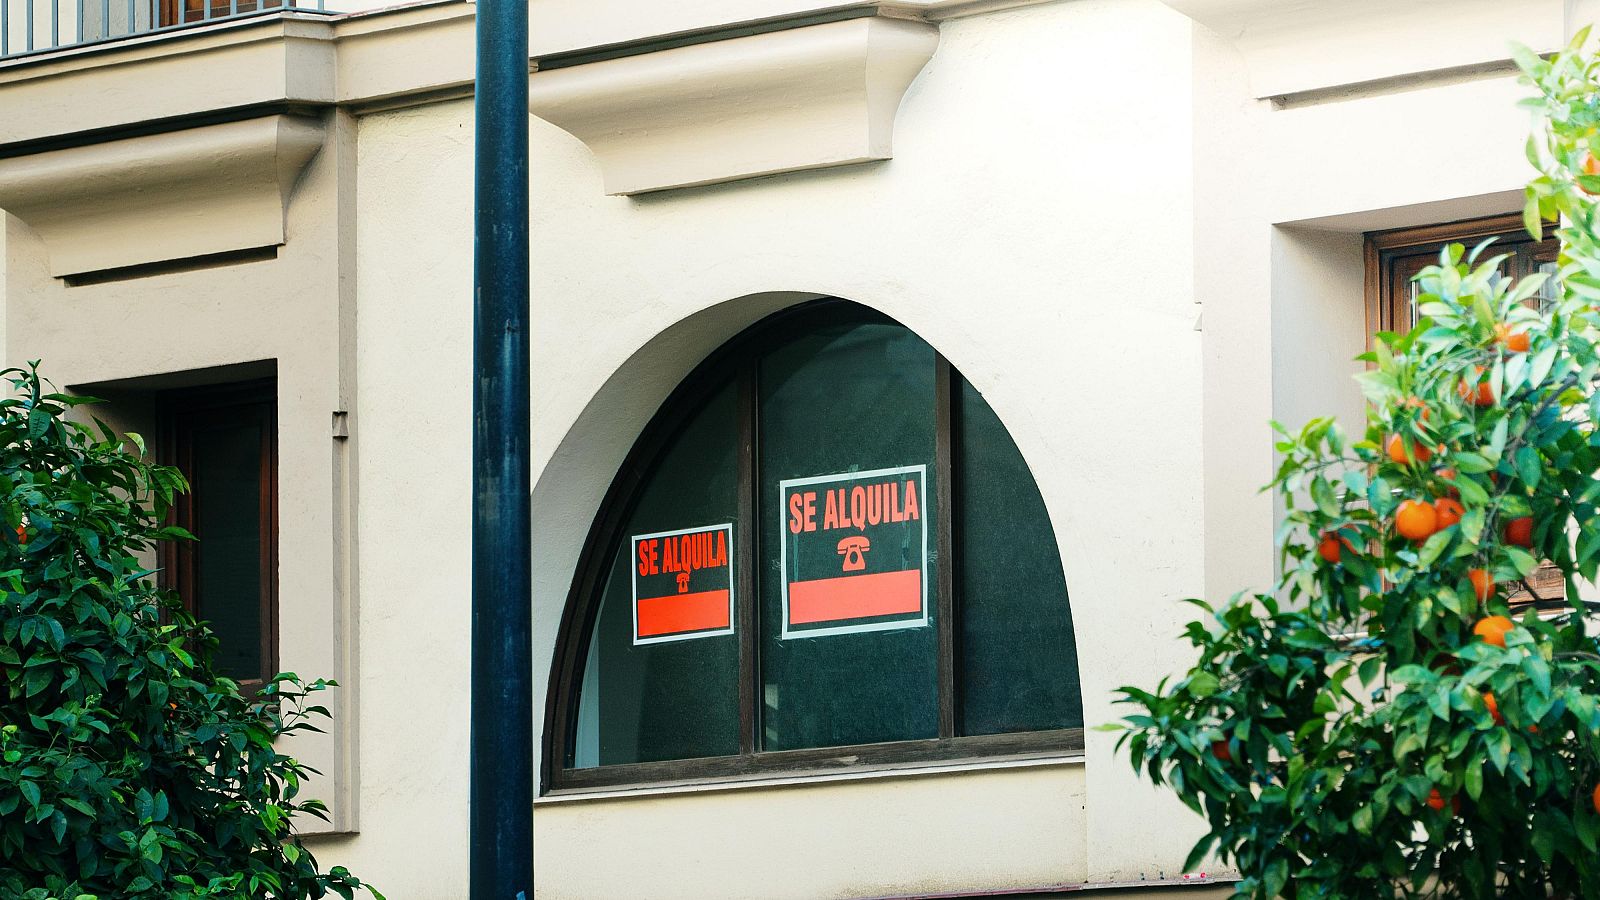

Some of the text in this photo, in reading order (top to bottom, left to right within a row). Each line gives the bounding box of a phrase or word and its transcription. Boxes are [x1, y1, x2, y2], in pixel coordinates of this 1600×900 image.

[789, 479, 919, 535] SE ALQUILA
[638, 530, 728, 577] SE ALQUILA
